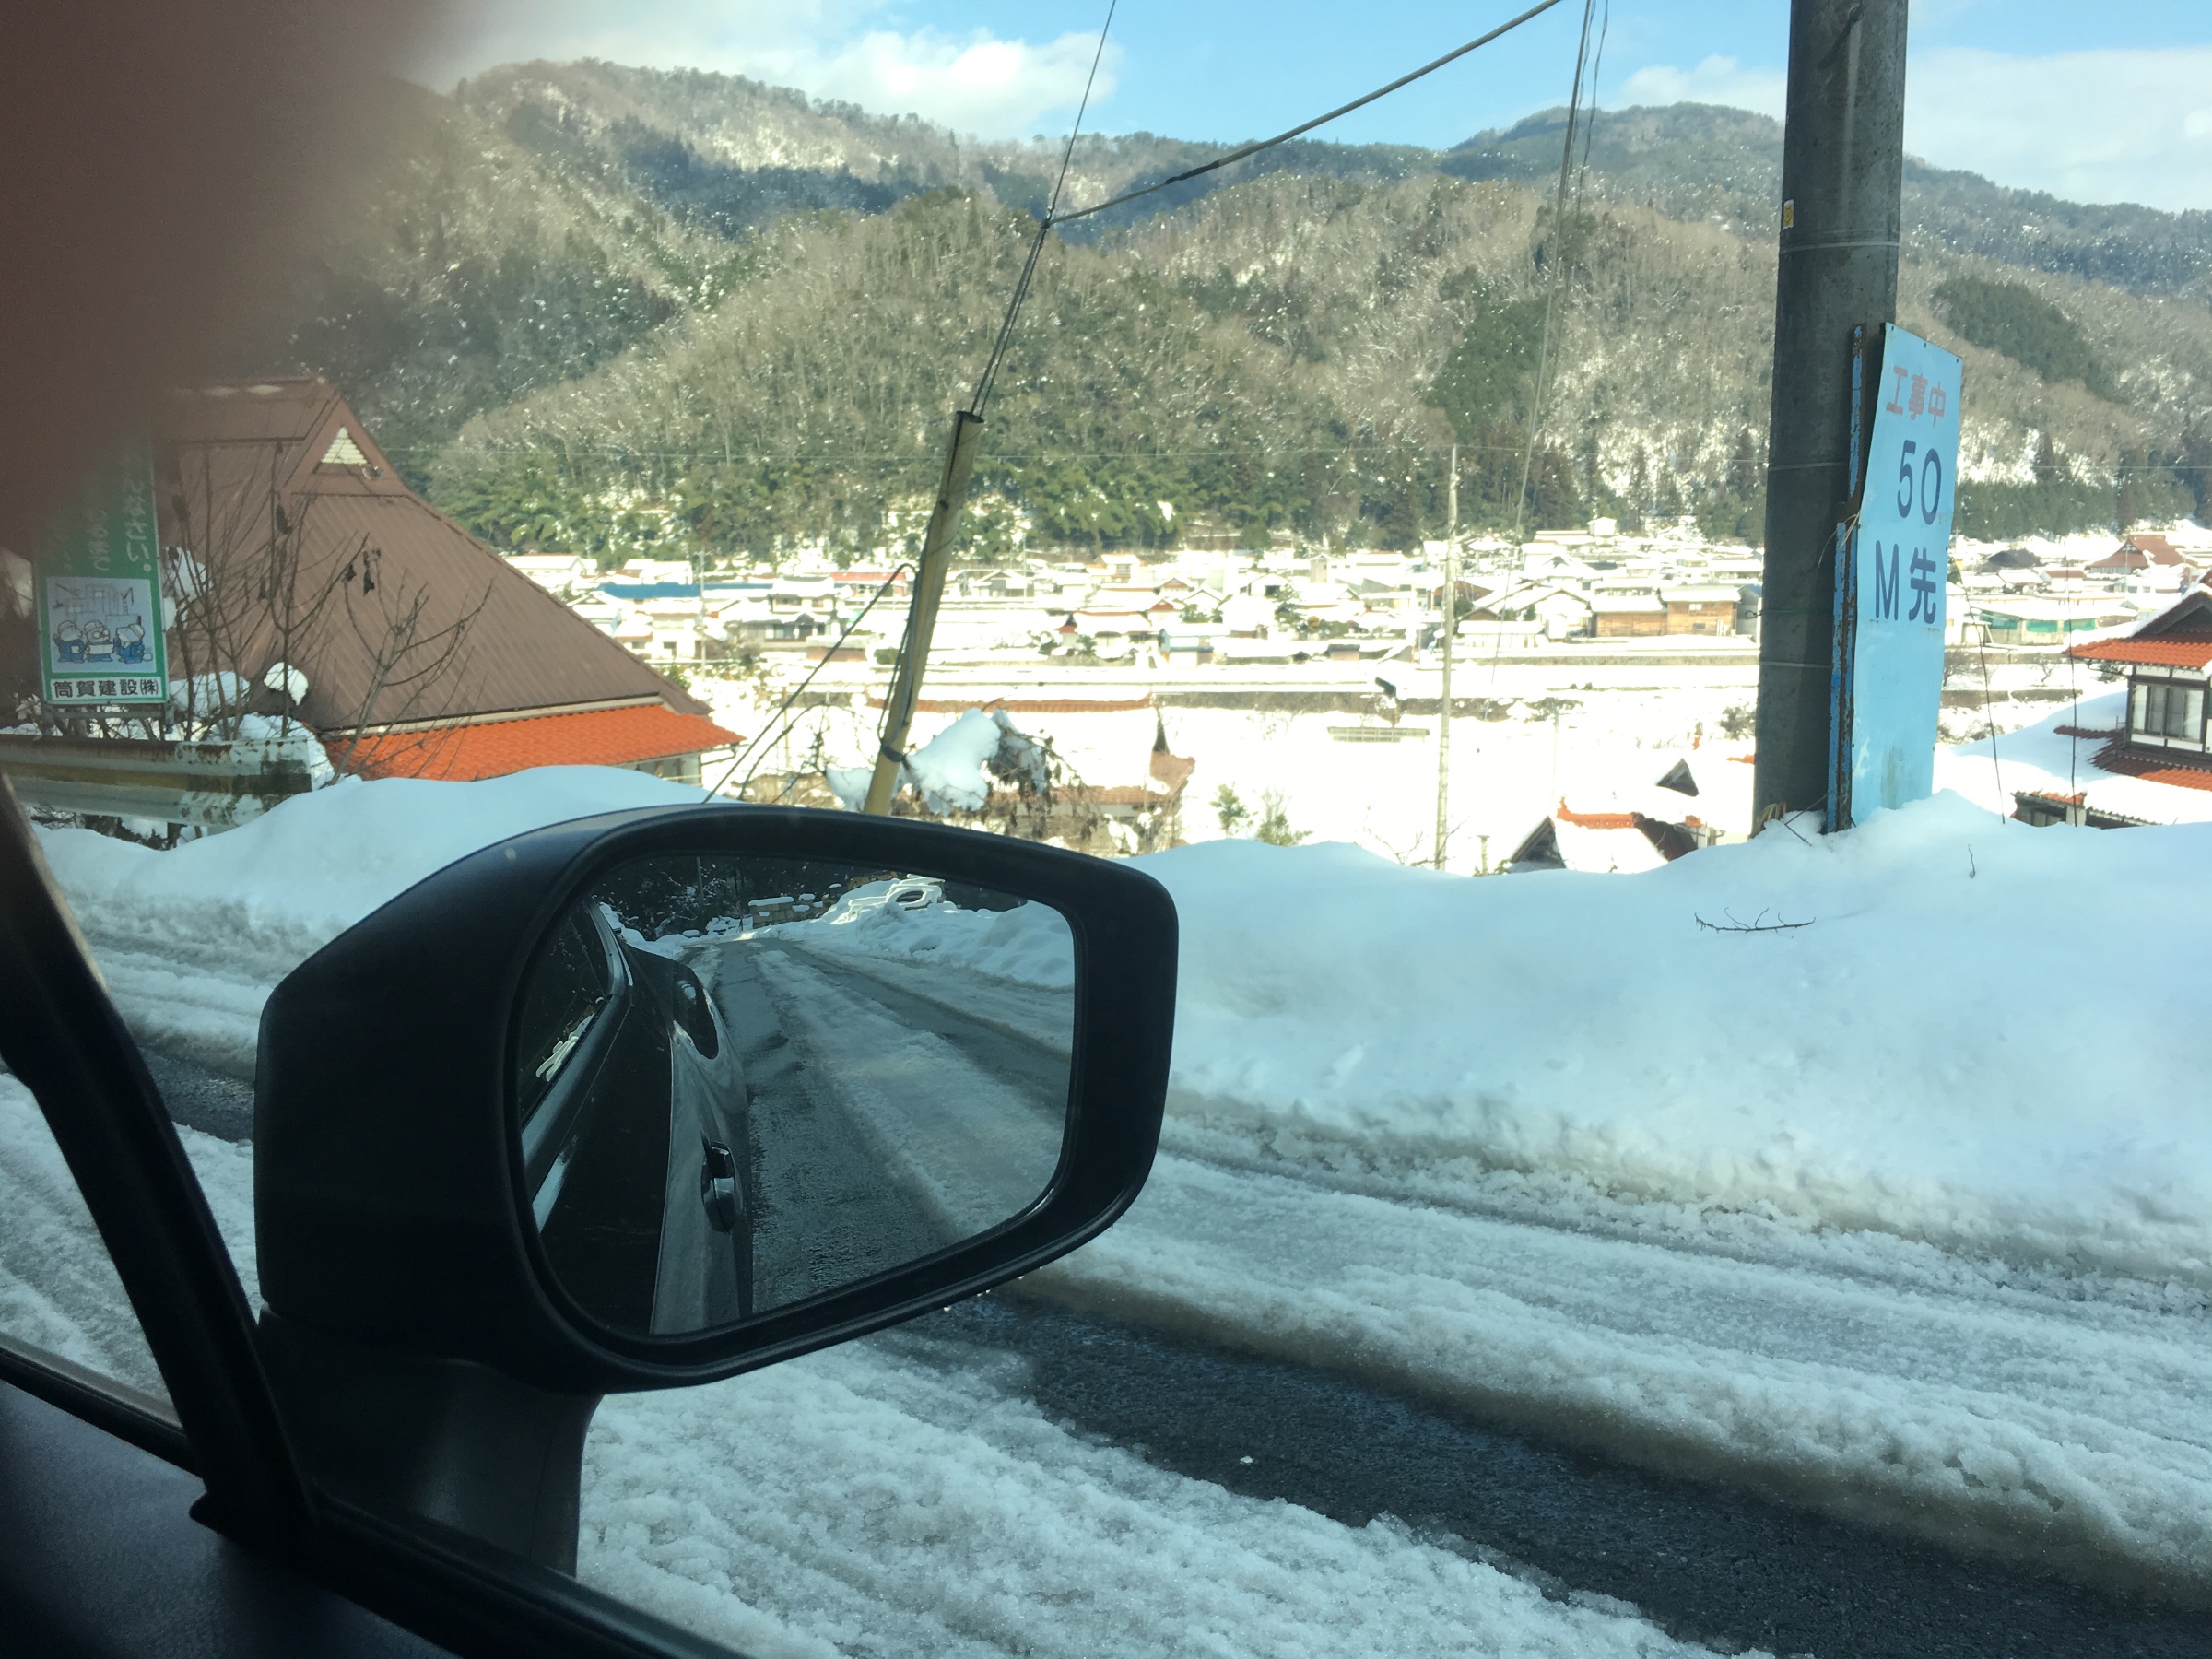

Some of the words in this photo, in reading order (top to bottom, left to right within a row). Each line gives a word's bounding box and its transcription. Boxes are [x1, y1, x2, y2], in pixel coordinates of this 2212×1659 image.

[1886, 365, 1947, 427] 工事中
[1897, 439, 1942, 526] 50
[1875, 540, 1936, 625] M先
